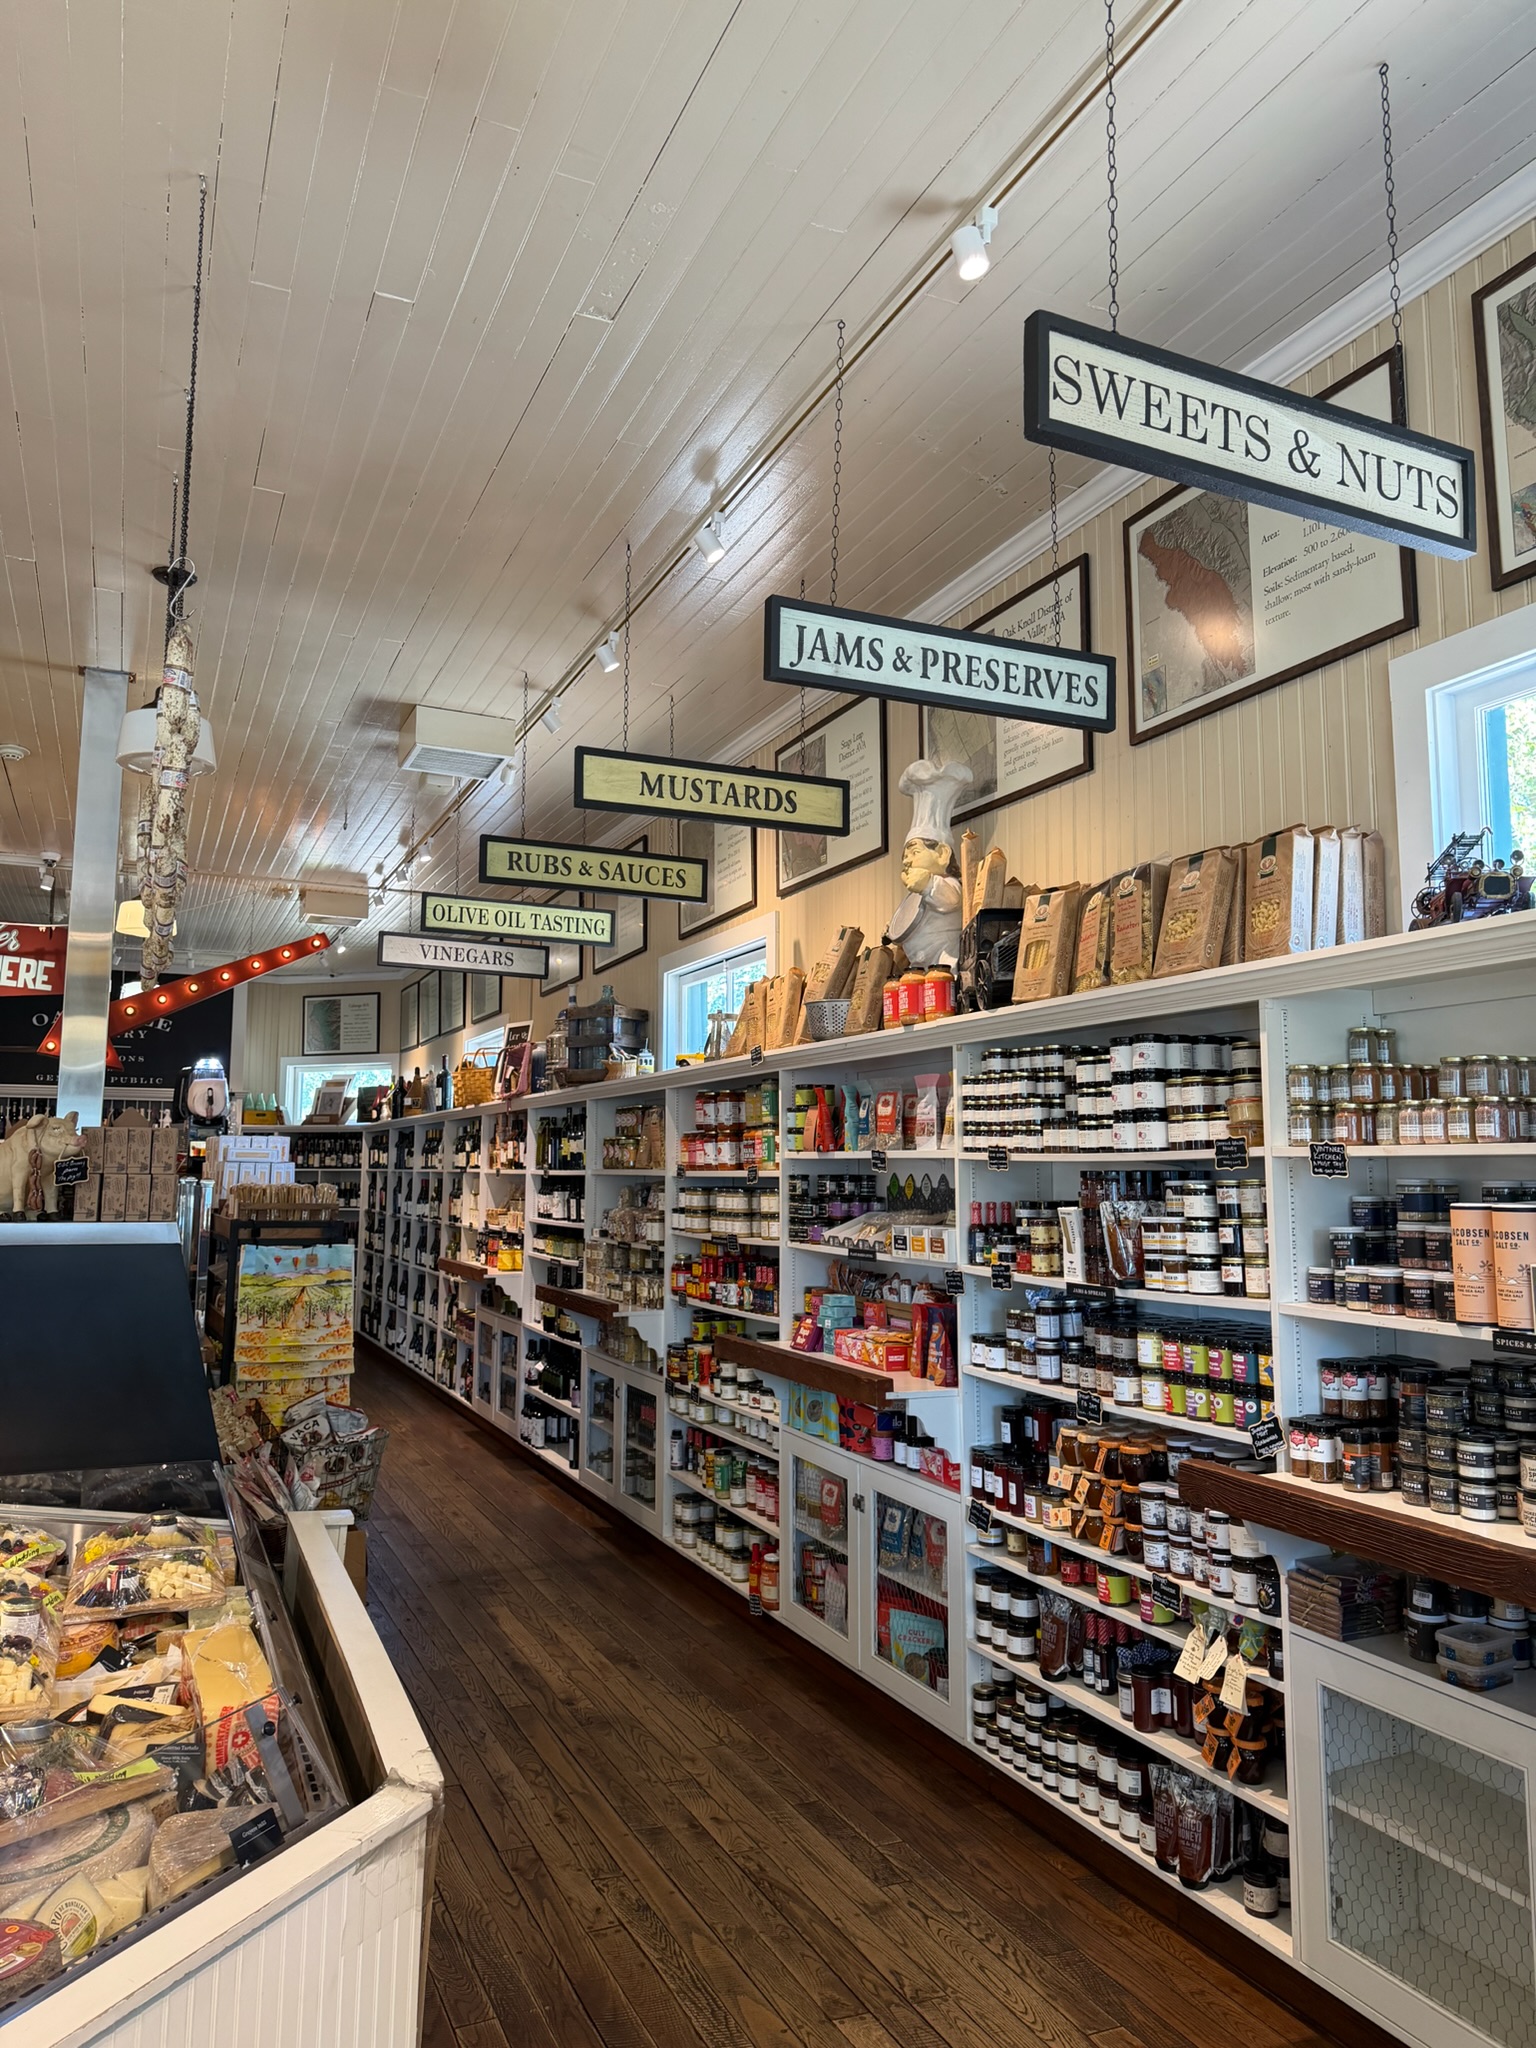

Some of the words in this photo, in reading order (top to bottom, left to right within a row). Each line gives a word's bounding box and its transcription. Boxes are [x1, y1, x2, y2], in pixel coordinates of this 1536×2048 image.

[1052, 354, 1272, 462] SWEETS
[1287, 429, 1321, 478] &
[1337, 441, 1459, 519] NUTS
[1261, 529, 1281, 545] Area:
[1263, 555, 1298, 578] Elevation:
[1303, 542, 1319, 557] 500
[1320, 539, 1328, 548] to
[1263, 582, 1284, 597] Soils:
[1284, 558, 1330, 586] Sedimentary
[1293, 584, 1311, 597] most
[1313, 572, 1330, 587] with
[1332, 551, 1376, 578] sandy-loam
[1002, 625, 1016, 638] Oak
[1018, 613, 1036, 630] Knoll
[1065, 588, 1074, 604] of
[1027, 623, 1048, 640] Valley
[789, 623, 883, 672] JAMS
[893, 646, 912, 672] &
[919, 645, 1100, 708] PRESERVES
[639, 771, 798, 815] MUSTARDS
[506, 850, 573, 877] RUBS
[578, 859, 594, 879] &
[598, 859, 687, 888] SAUCES
[431, 902, 490, 928] OLIVE
[494, 908, 525, 929] OIL
[529, 909, 606, 938] TASTING
[419, 943, 515, 968] VINEGARS
[0, 955, 55, 991] ERE
[110, 1076, 164, 1084] PUBLIC
[1453, 1228, 1490, 1238] ACOBSEN
[1493, 1231, 1529, 1241] COBSEN
[1496, 1338, 1525, 1348] SPICES
[897, 1635, 935, 1646] CRACKERS
[908, 1629, 925, 1637] CULT
[1178, 1815, 1203, 1833] CHICO
